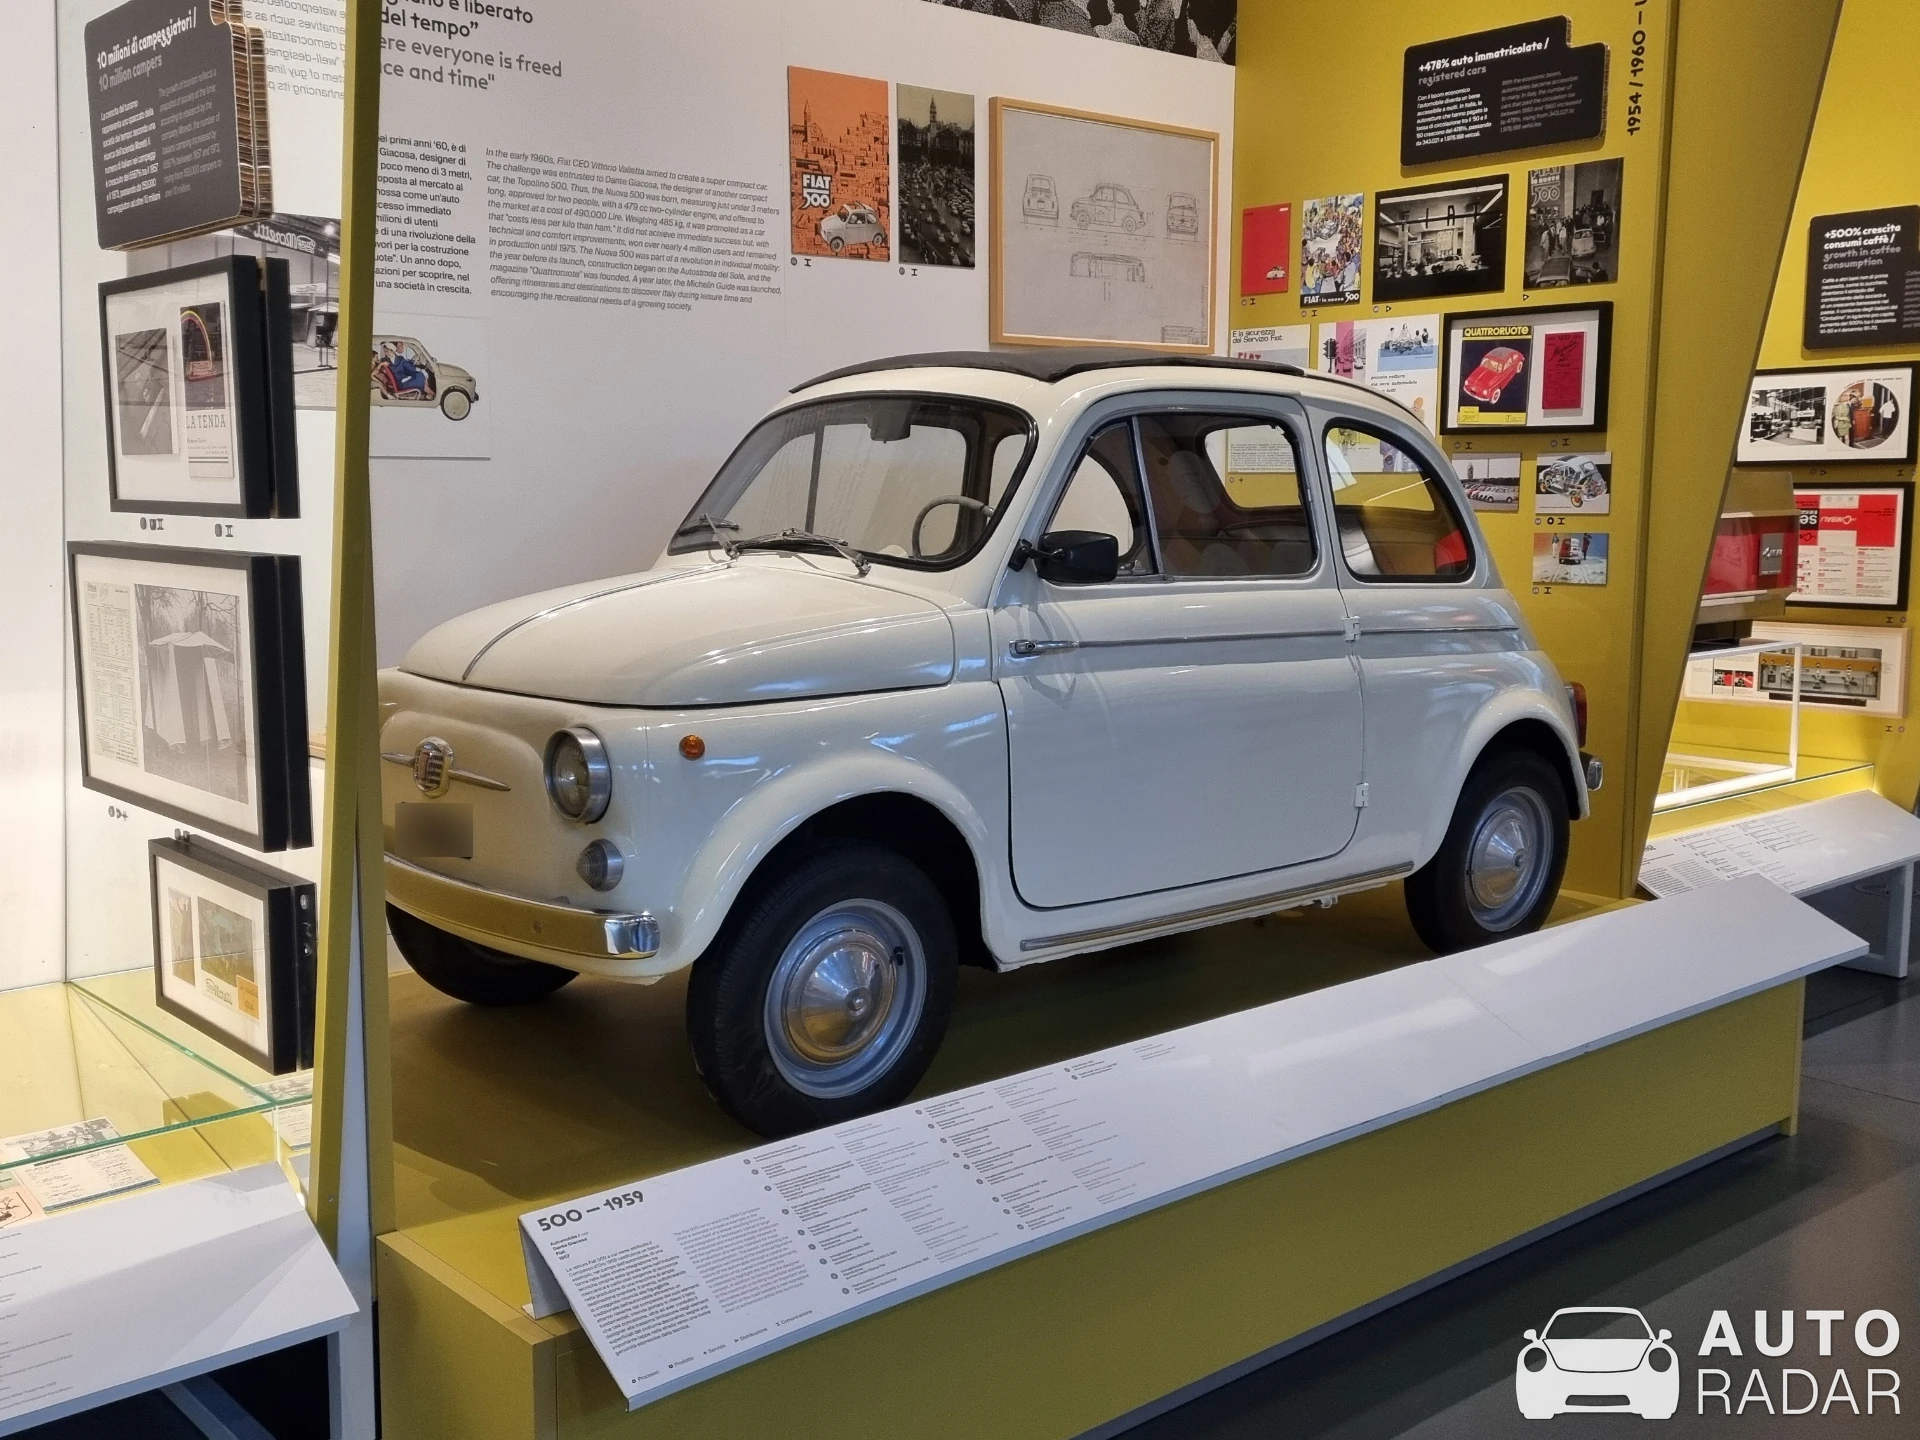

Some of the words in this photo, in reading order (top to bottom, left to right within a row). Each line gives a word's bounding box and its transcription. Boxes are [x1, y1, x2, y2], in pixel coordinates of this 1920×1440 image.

[382, 7, 406, 26] del
[464, 0, 534, 23] liberato
[97, 51, 107, 69] 10
[108, 39, 130, 65] milioni
[131, 35, 138, 54] di
[138, 10, 192, 51] campeggiatori
[412, 41, 494, 66] everyone
[499, 51, 512, 69] is
[516, 54, 562, 78] freed
[1418, 58, 1450, 72] +478%
[1451, 54, 1474, 66] auto
[1474, 41, 1542, 62] immatricolate
[1630, 30, 1646, 77] 1960
[99, 74, 108, 92] 10
[110, 66, 132, 87] million
[133, 54, 162, 78] campers
[381, 62, 404, 77] ce
[410, 66, 444, 82] and
[1418, 67, 1464, 86] registered
[1466, 65, 1486, 76] cars
[1628, 92, 1642, 136] 1954
[390, 136, 412, 146] primi
[414, 139, 432, 148] anni
[459, 144, 466, 153] di
[380, 148, 418, 160] Giacosa,
[420, 152, 456, 164] designer
[458, 158, 466, 166] di
[380, 162, 403, 172] poco
[404, 165, 430, 174] meno
[432, 167, 439, 176] di
[441, 168, 446, 176] 3
[448, 170, 472, 180] metri,
[486, 148, 494, 156] In
[495, 150, 508, 158] the
[510, 152, 528, 161] early
[557, 157, 570, 166] Fiat
[572, 159, 589, 168] CEO
[591, 161, 616, 172] Vittorio
[646, 168, 668, 178] aimed
[678, 174, 700, 182] create
[706, 178, 726, 186] super
[726, 180, 755, 190] compact
[420, 180, 454, 190] mercato
[456, 183, 463, 191] al
[803, 174, 831, 190] FIAT
[403, 191, 428, 200] come
[802, 188, 830, 208] 500
[406, 203, 452, 216] immediato
[404, 216, 412, 224] di
[414, 218, 438, 228] utenti
[391, 230, 406, 238] una
[409, 230, 454, 242] rivoluzione
[456, 234, 476, 244] della
[1824, 227, 1861, 239] +500%
[1862, 224, 1901, 235] crescita
[394, 242, 408, 250] per
[411, 243, 418, 252] la
[420, 245, 469, 256] costruzione
[1824, 238, 1862, 250] consumi
[1863, 234, 1888, 246] caffè
[400, 254, 412, 263] Un
[415, 257, 436, 266] anno
[438, 258, 461, 268] dopo,
[1823, 249, 1858, 262] growth
[1870, 245, 1901, 254] coffee
[1823, 258, 1883, 270] consumption
[402, 268, 416, 277] per
[419, 270, 456, 280] scoprire,
[376, 280, 392, 288] una
[394, 281, 425, 290] società
[427, 283, 434, 292] in
[436, 284, 472, 294] crescita.
[1344, 292, 1360, 303] 500
[186, 416, 196, 428] LA
[198, 414, 226, 428] TENDA
[537, 1209, 582, 1232] 500
[603, 1190, 644, 1211] 1959
[781, 1310, 812, 1325] Comunicazione
[740, 1327, 768, 1342] Distribuzione
[708, 1344, 726, 1354] Servizio
[674, 1356, 694, 1368] Prodotto
[638, 1370, 660, 1382] Processo
